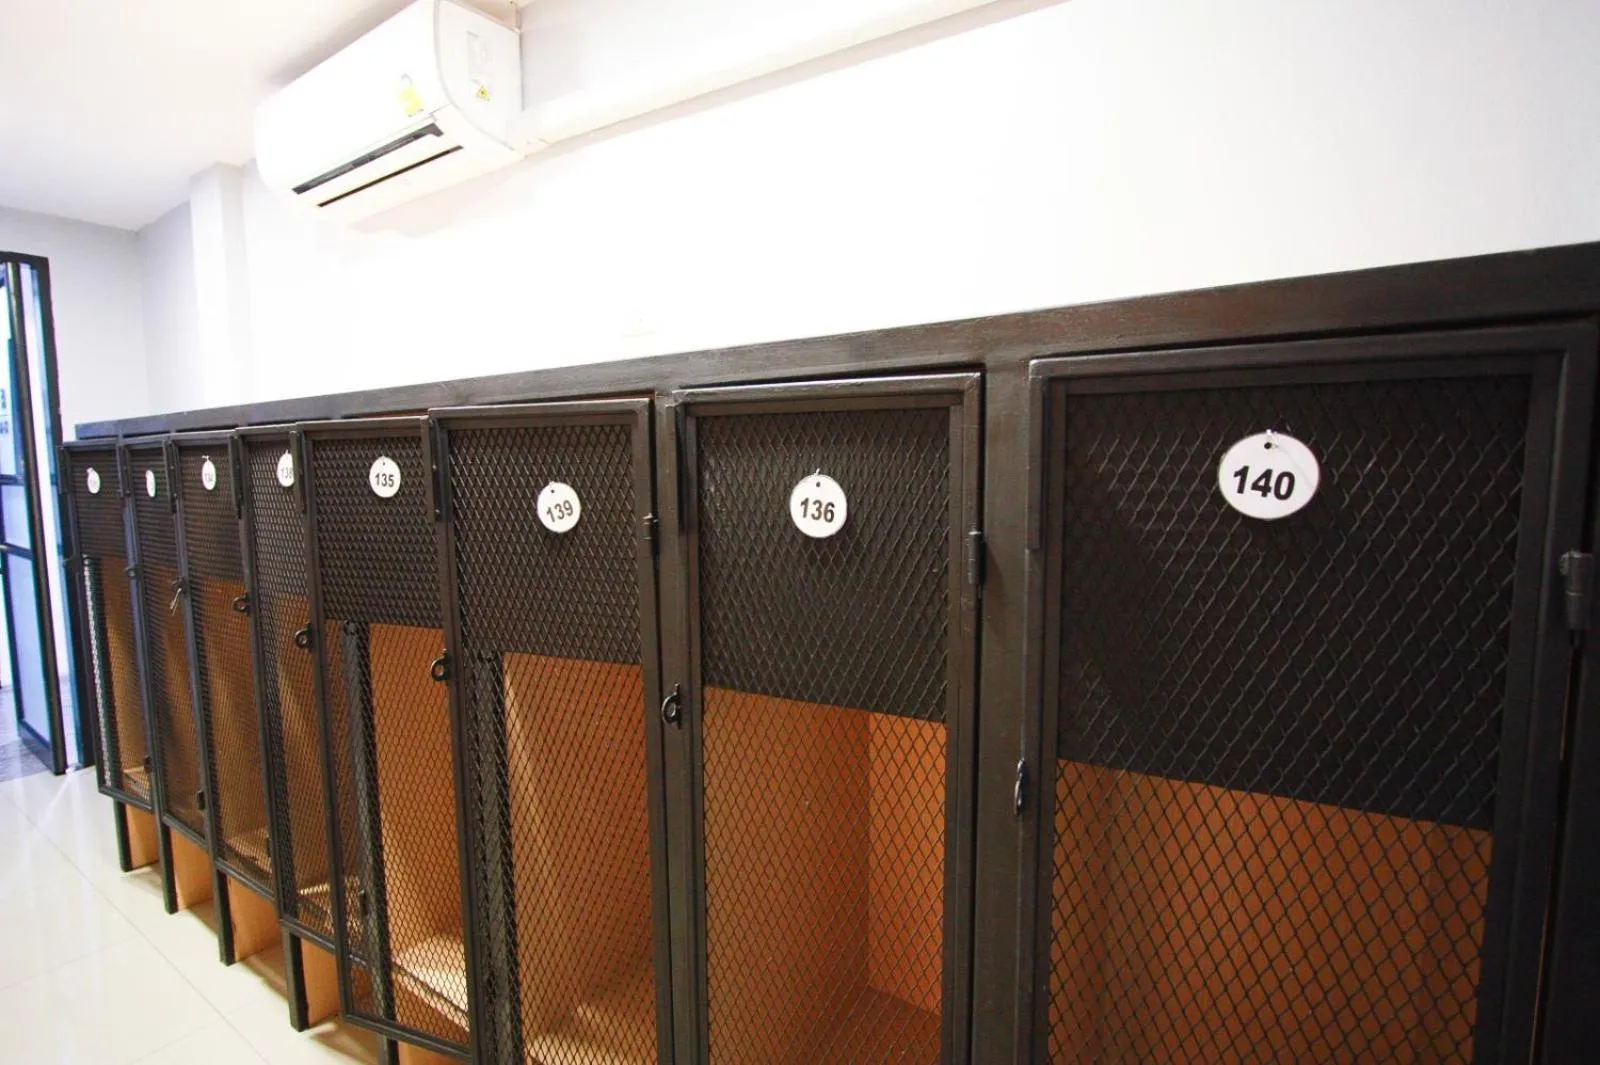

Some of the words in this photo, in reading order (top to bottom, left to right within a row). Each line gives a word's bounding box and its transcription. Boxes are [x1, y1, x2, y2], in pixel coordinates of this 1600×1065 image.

[375, 473, 395, 487] 135
[1233, 465, 1296, 501] 140
[546, 500, 574, 523] 139
[800, 497, 835, 523] 136
